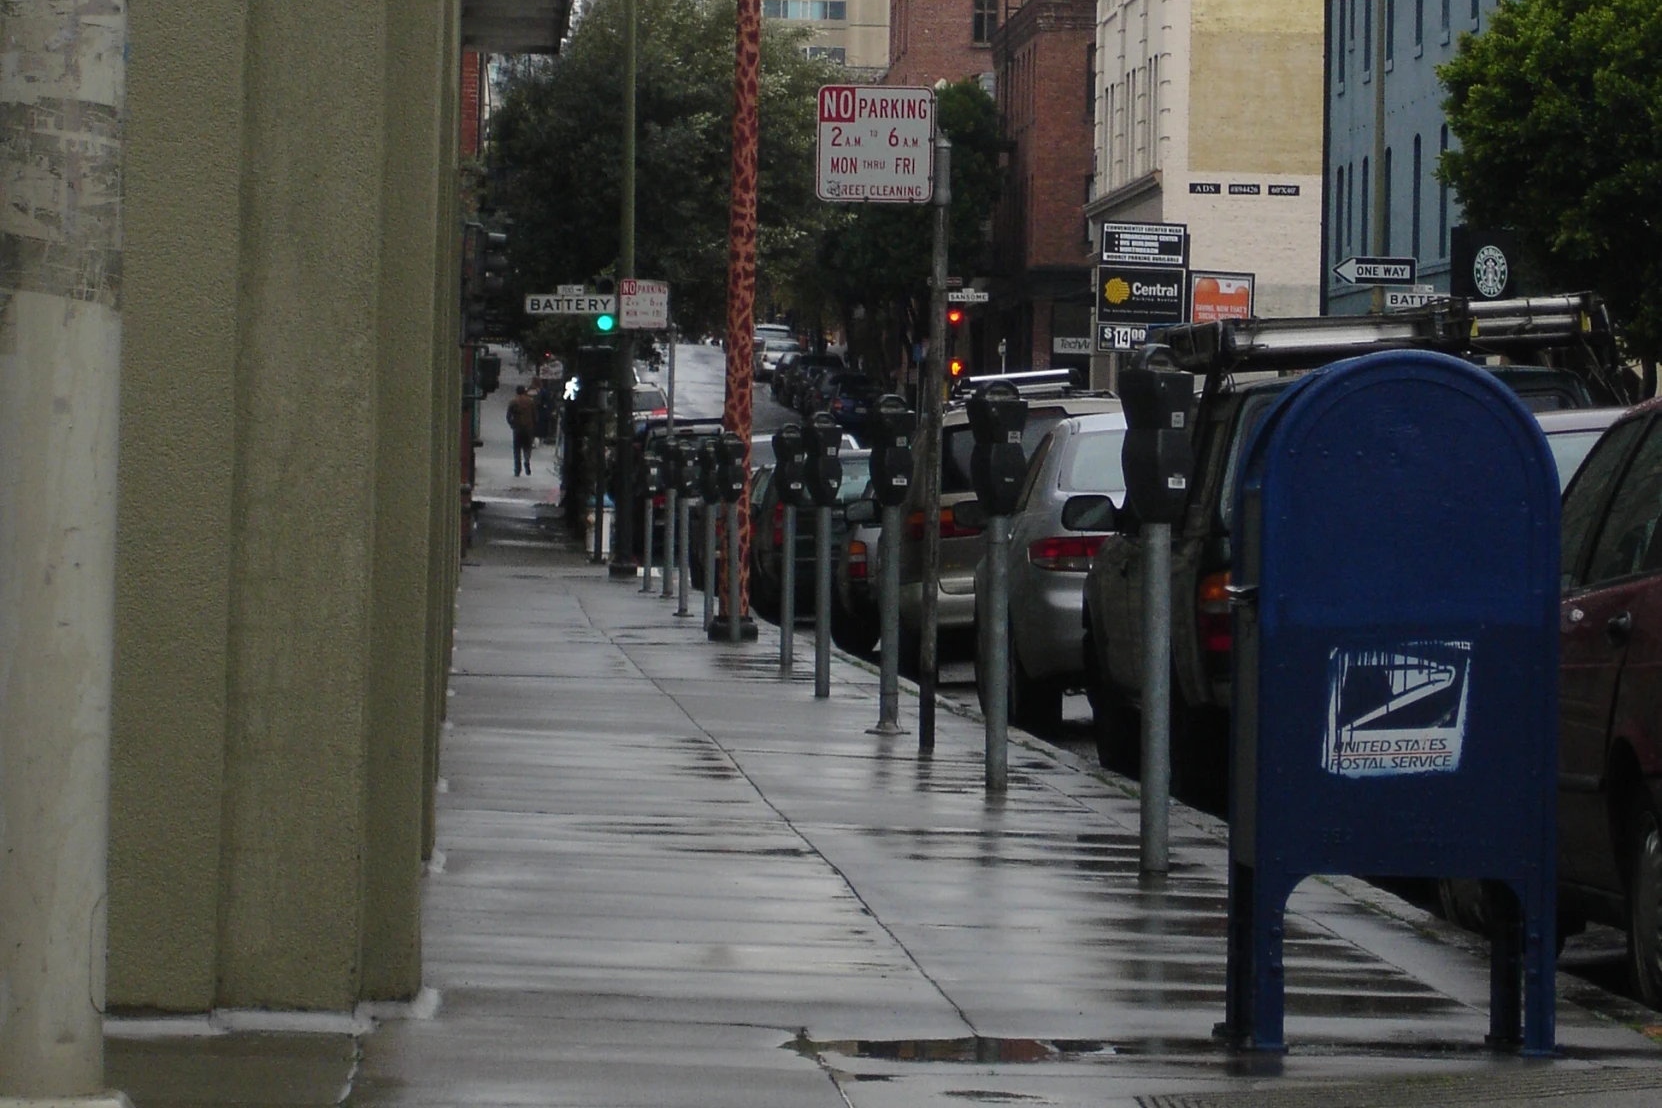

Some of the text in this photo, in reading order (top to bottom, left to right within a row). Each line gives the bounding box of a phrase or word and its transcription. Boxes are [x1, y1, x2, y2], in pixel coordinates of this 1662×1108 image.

[823, 89, 928, 120] NO PARKING
[831, 126, 843, 147] 2
[888, 127, 900, 148] 6
[830, 156, 916, 176] MON THRU FRI
[827, 183, 922, 197] REET CLEANING
[1195, 184, 1216, 193] ADS
[1356, 265, 1407, 277] ONE WAY
[622, 281, 636, 295] NO
[1132, 281, 1178, 297] Central
[950, 293, 987, 301] SANSOME
[1390, 294, 1443, 307] BATTE
[530, 298, 611, 311] BATTERY
[1332, 740, 1392, 754] UNITED
[1329, 754, 1453, 771] POSTAL SERVICE
